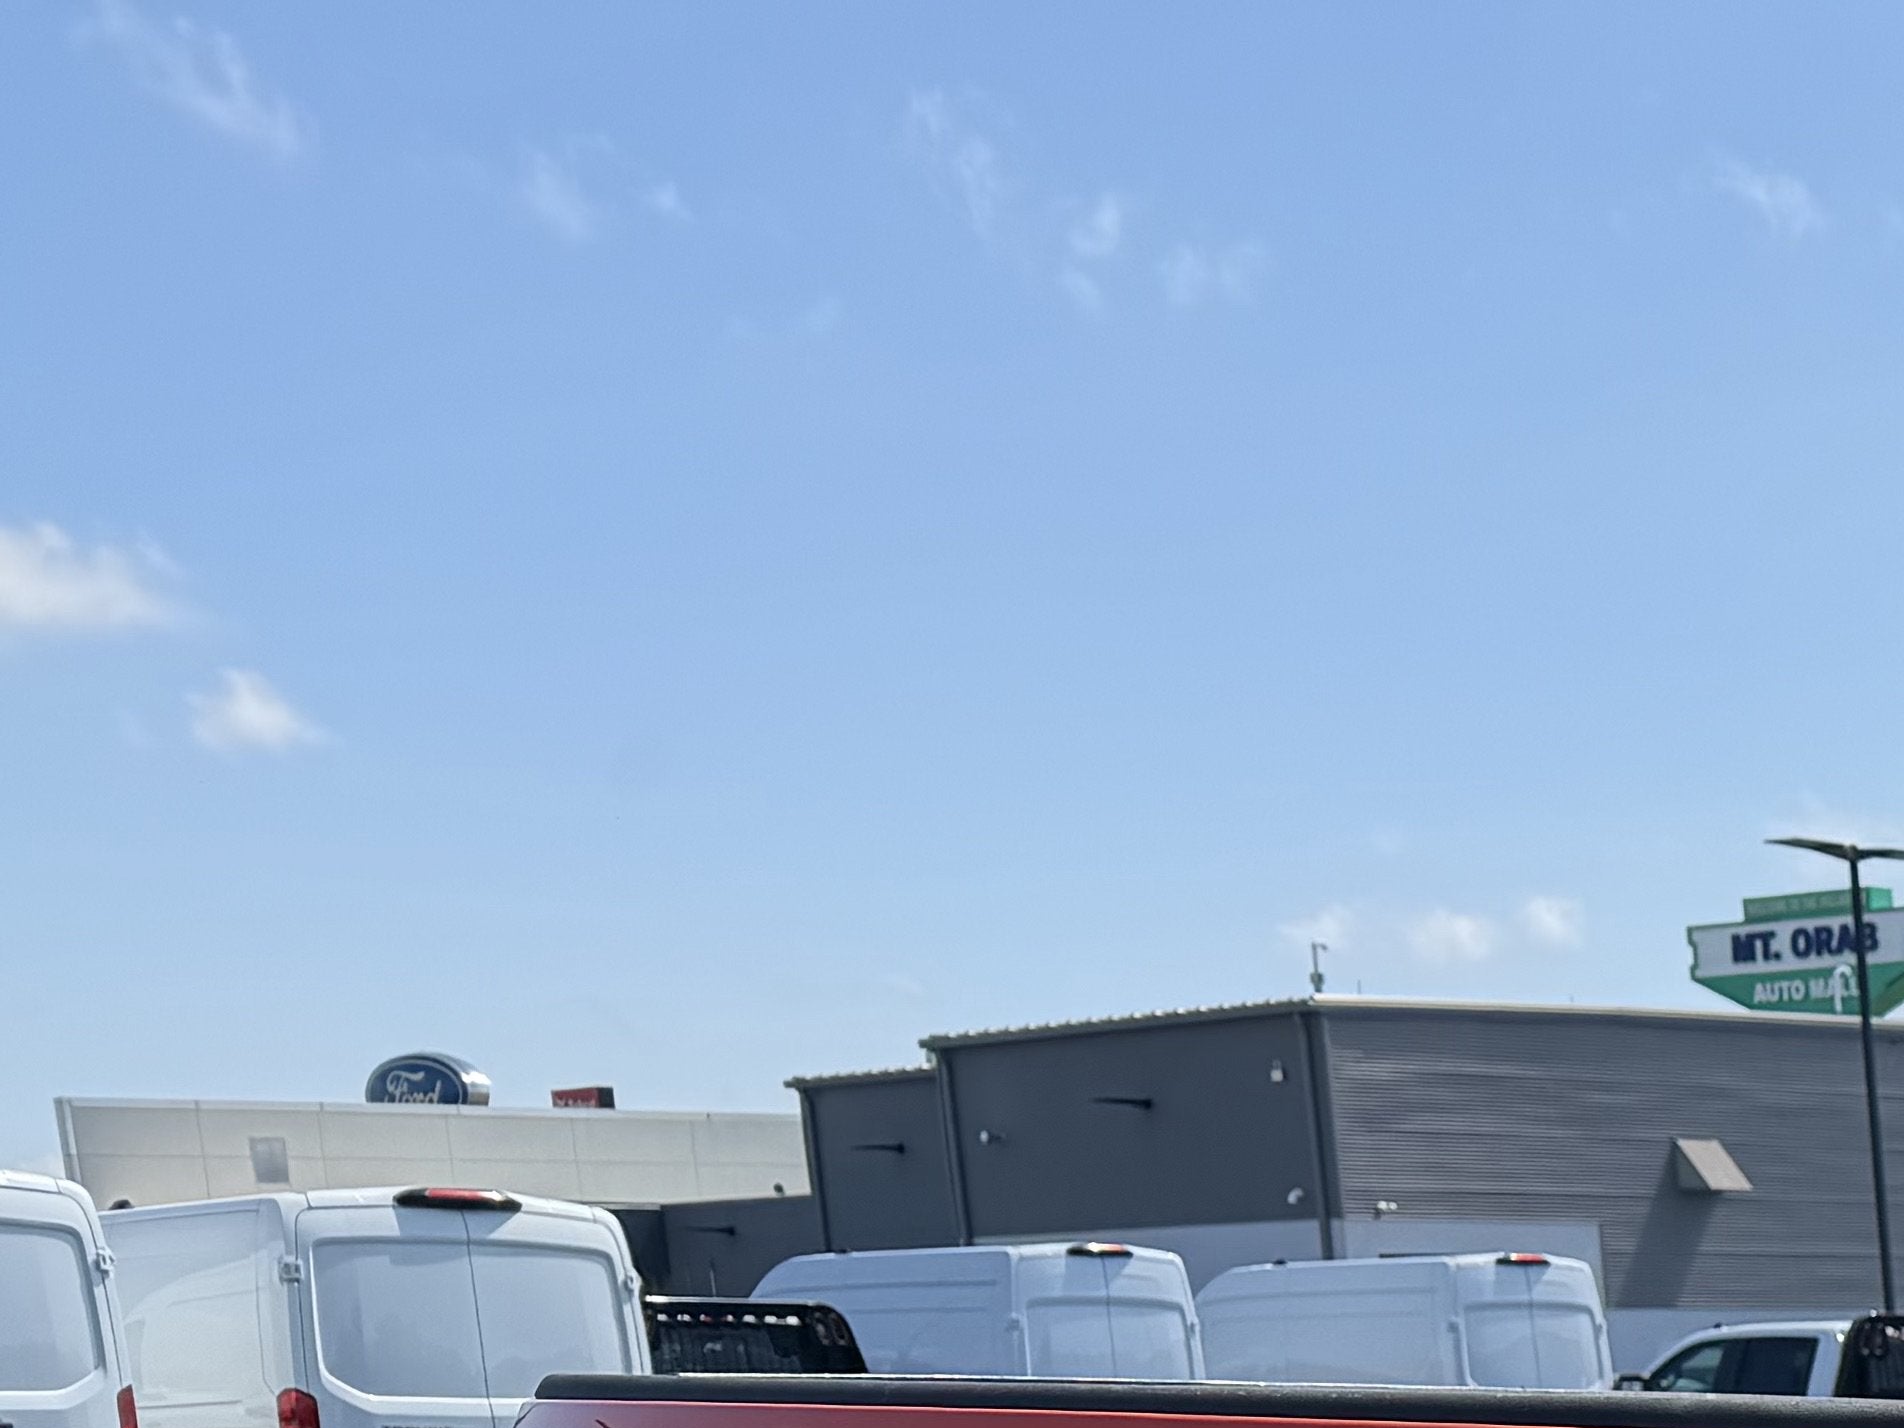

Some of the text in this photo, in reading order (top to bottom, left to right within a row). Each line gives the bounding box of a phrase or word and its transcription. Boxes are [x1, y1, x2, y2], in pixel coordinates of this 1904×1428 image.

[1730, 921, 1879, 963] MT. ORAB
[1753, 979, 1803, 1005] AUTO
[385, 1071, 442, 1104] Ford
